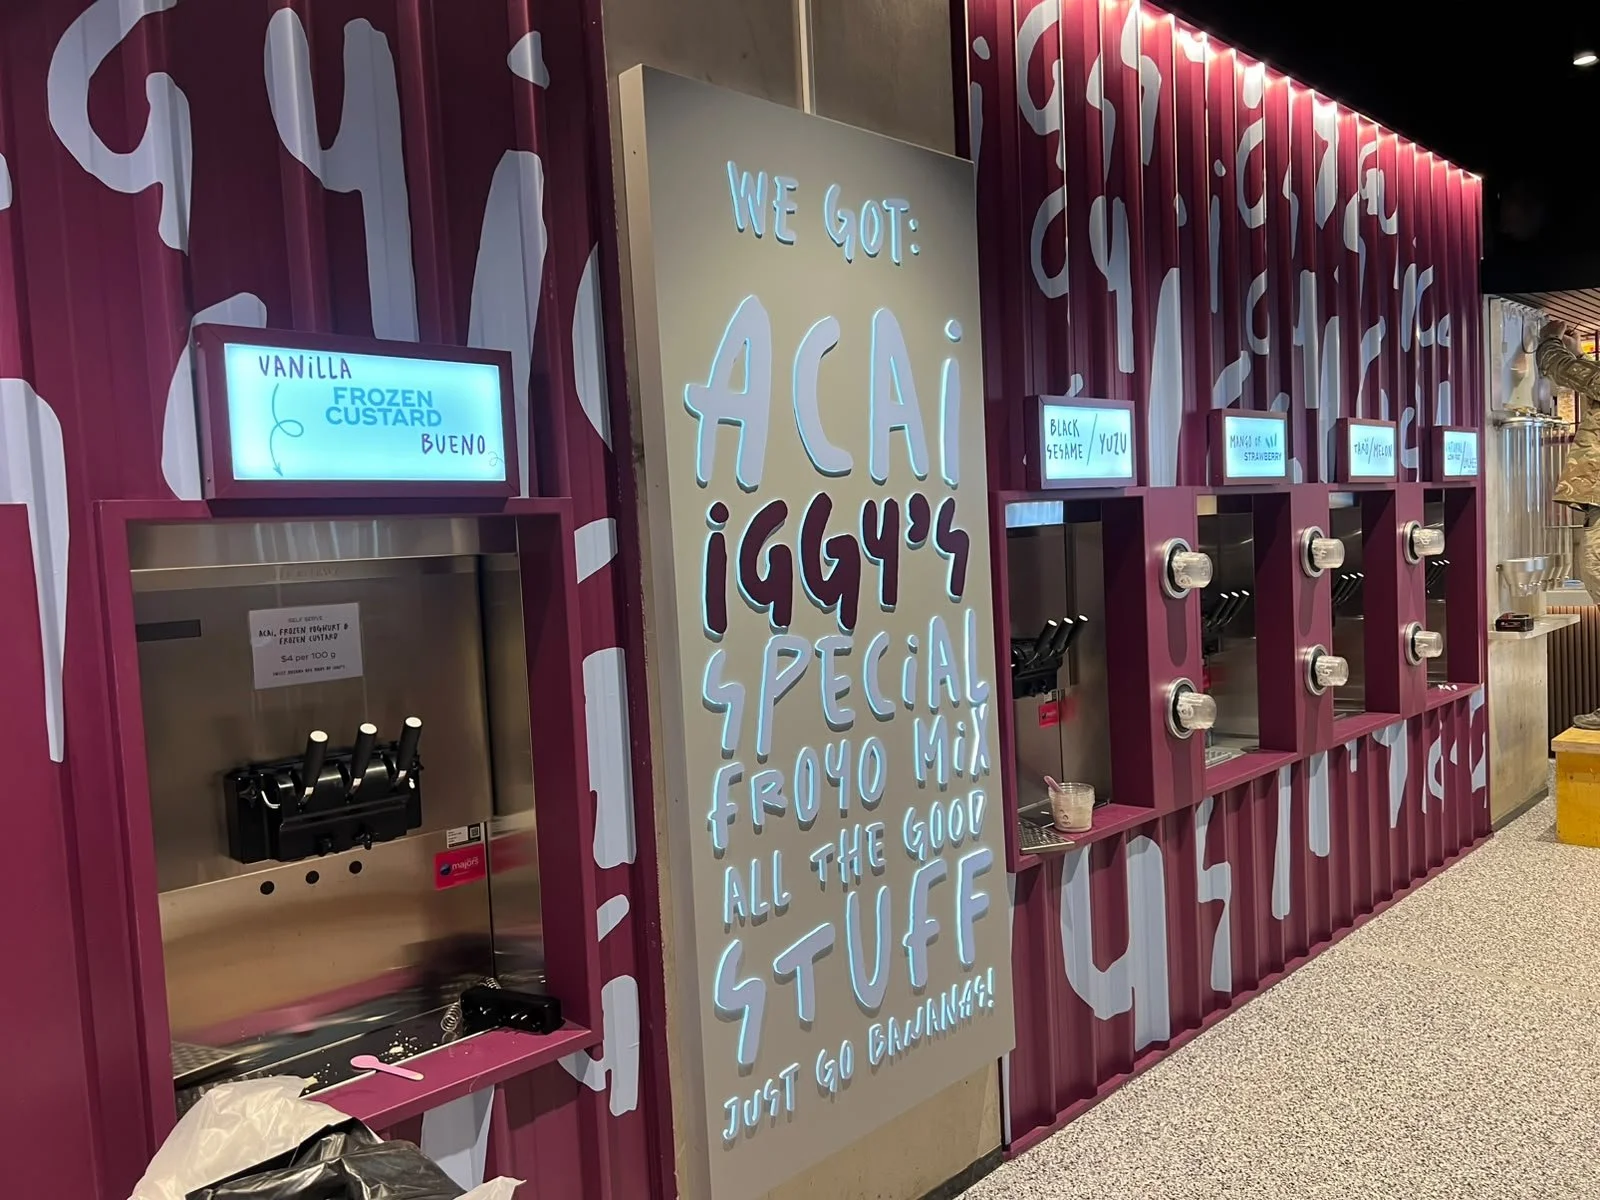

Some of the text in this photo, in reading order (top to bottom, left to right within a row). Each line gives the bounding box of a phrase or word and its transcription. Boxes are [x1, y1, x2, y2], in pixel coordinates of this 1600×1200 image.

[727, 160, 920, 265] WE GOT:
[258, 354, 352, 380] VANiLLA
[333, 386, 434, 408] FROZEN
[684, 294, 962, 491] ACAi
[325, 406, 442, 427] CUSTARD
[1050, 418, 1080, 438] BLACK
[421, 433, 486, 455] BUENO
[1046, 443, 1083, 460] SESAME
[1099, 432, 1127, 456] YUZU
[1244, 451, 1282, 462] STRAWBERRY
[279, 626, 306, 636] FROZEN
[309, 623, 340, 634] YOGHURT
[279, 632, 338, 645] FROZEN CUSTARD
[295, 653, 309, 662] per
[311, 651, 328, 660] 100
[330, 651, 336, 659] g
[703, 608, 989, 758] SPECiAL
[707, 703, 991, 851] FROYO MiX
[724, 790, 987, 927] ALL THE GOOD
[715, 848, 994, 1068] STUFF
[723, 1062, 800, 1141] JUST
[816, 1040, 854, 1094] GO
